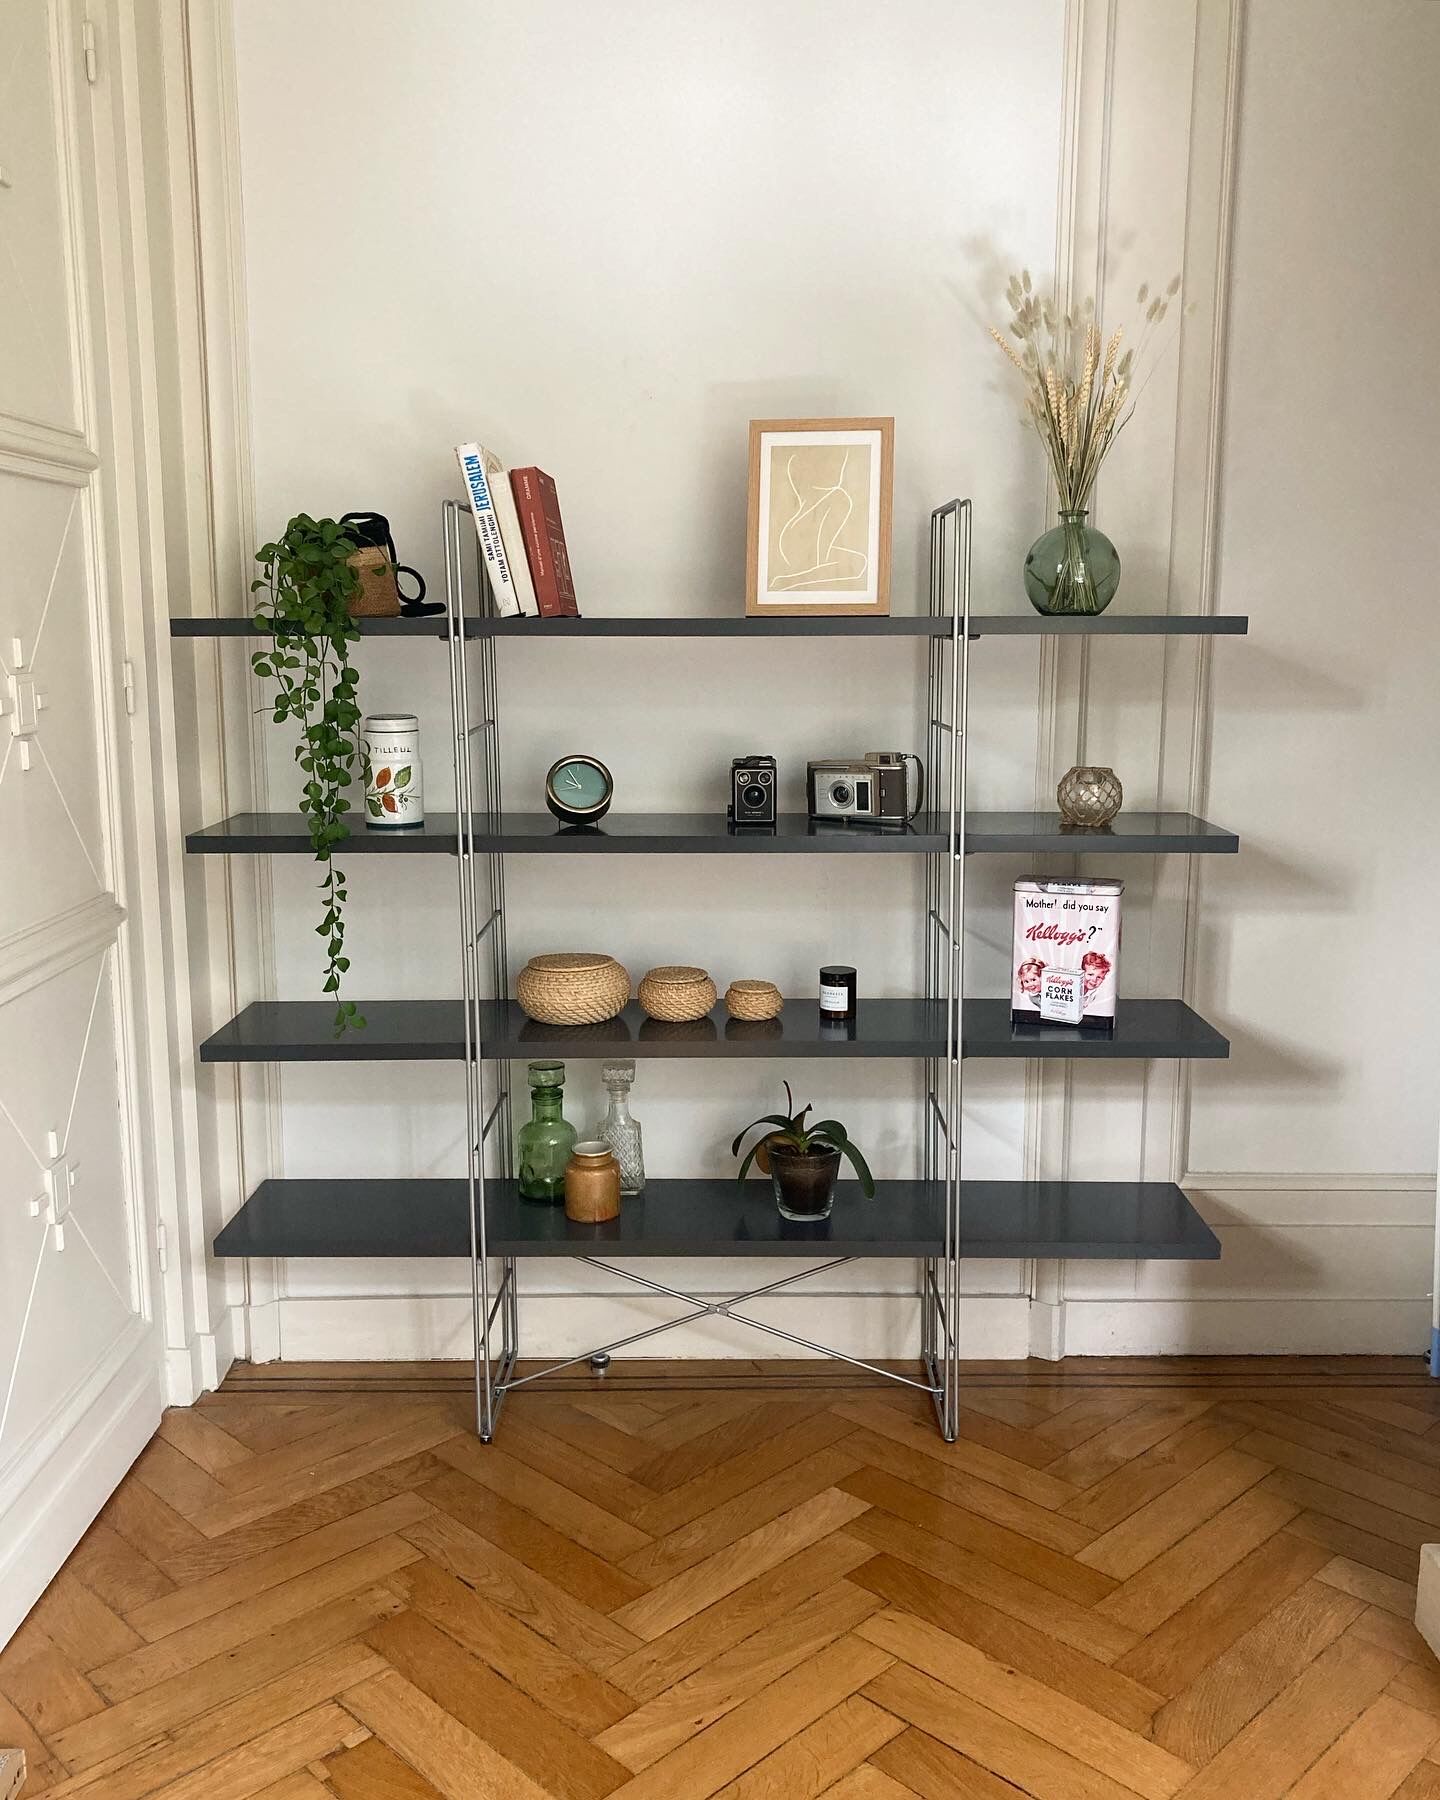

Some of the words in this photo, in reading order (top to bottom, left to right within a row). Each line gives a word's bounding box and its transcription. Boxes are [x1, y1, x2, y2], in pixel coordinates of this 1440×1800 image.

[464, 455, 491, 511] JERUSALEM
[479, 516, 490, 541] TAMIMI
[487, 514, 502, 557] OTTOLENGHI
[485, 542, 495, 561] SAMI
[498, 559, 509, 583] YOTAM
[374, 746, 412, 754] TILLEUL
[1062, 900, 1076, 910] did
[1078, 903, 1094, 912] you
[1095, 905, 1109, 913] say
[1045, 992, 1074, 1002] FLAKES
[1047, 985, 1073, 995] CORN
